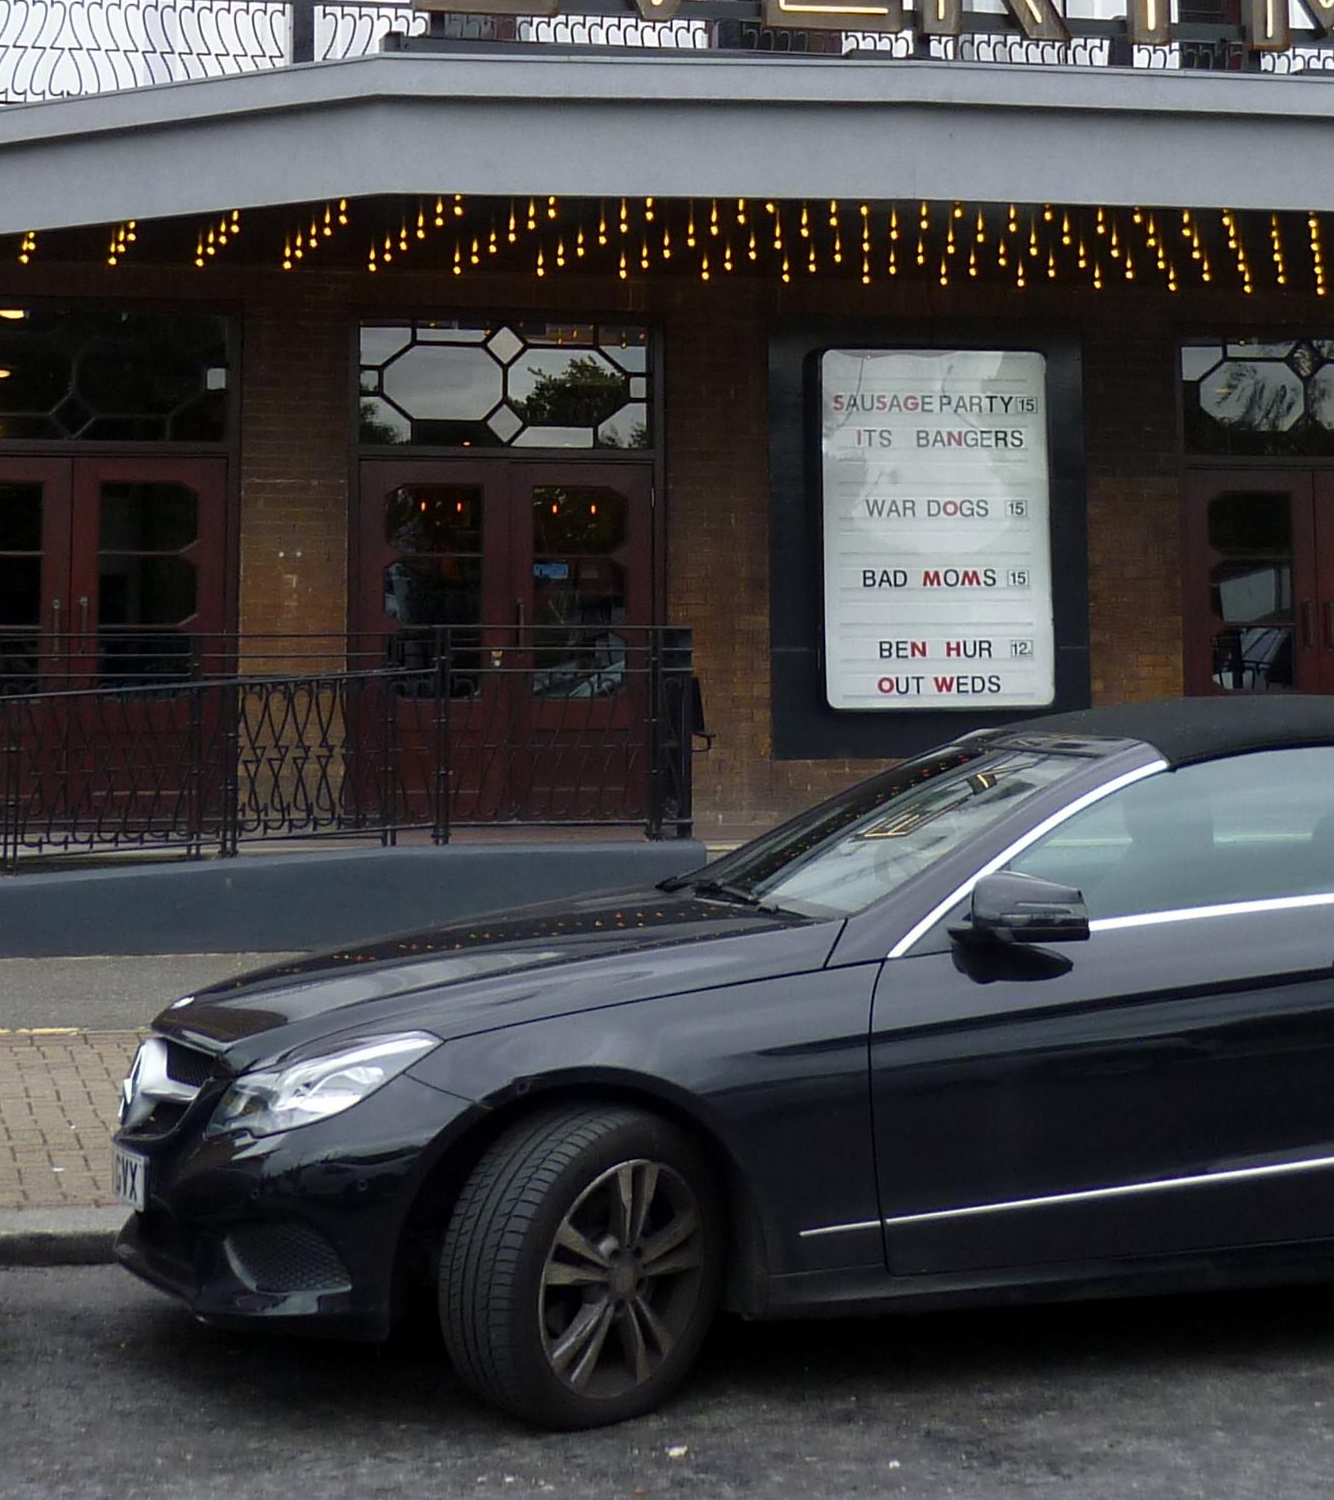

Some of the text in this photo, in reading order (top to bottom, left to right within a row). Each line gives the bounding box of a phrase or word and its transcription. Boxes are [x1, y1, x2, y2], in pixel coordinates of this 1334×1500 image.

[833, 395, 1036, 413] SAUSAGE PARTY 15
[856, 430, 1024, 448] ITS BANGERS
[866, 500, 1025, 517] WAR DOGS 15
[862, 569, 1027, 587] BAD MOMS 15
[879, 640, 927, 659] BEN
[945, 640, 993, 658] HUR
[877, 675, 1001, 694] OUT WEDS
